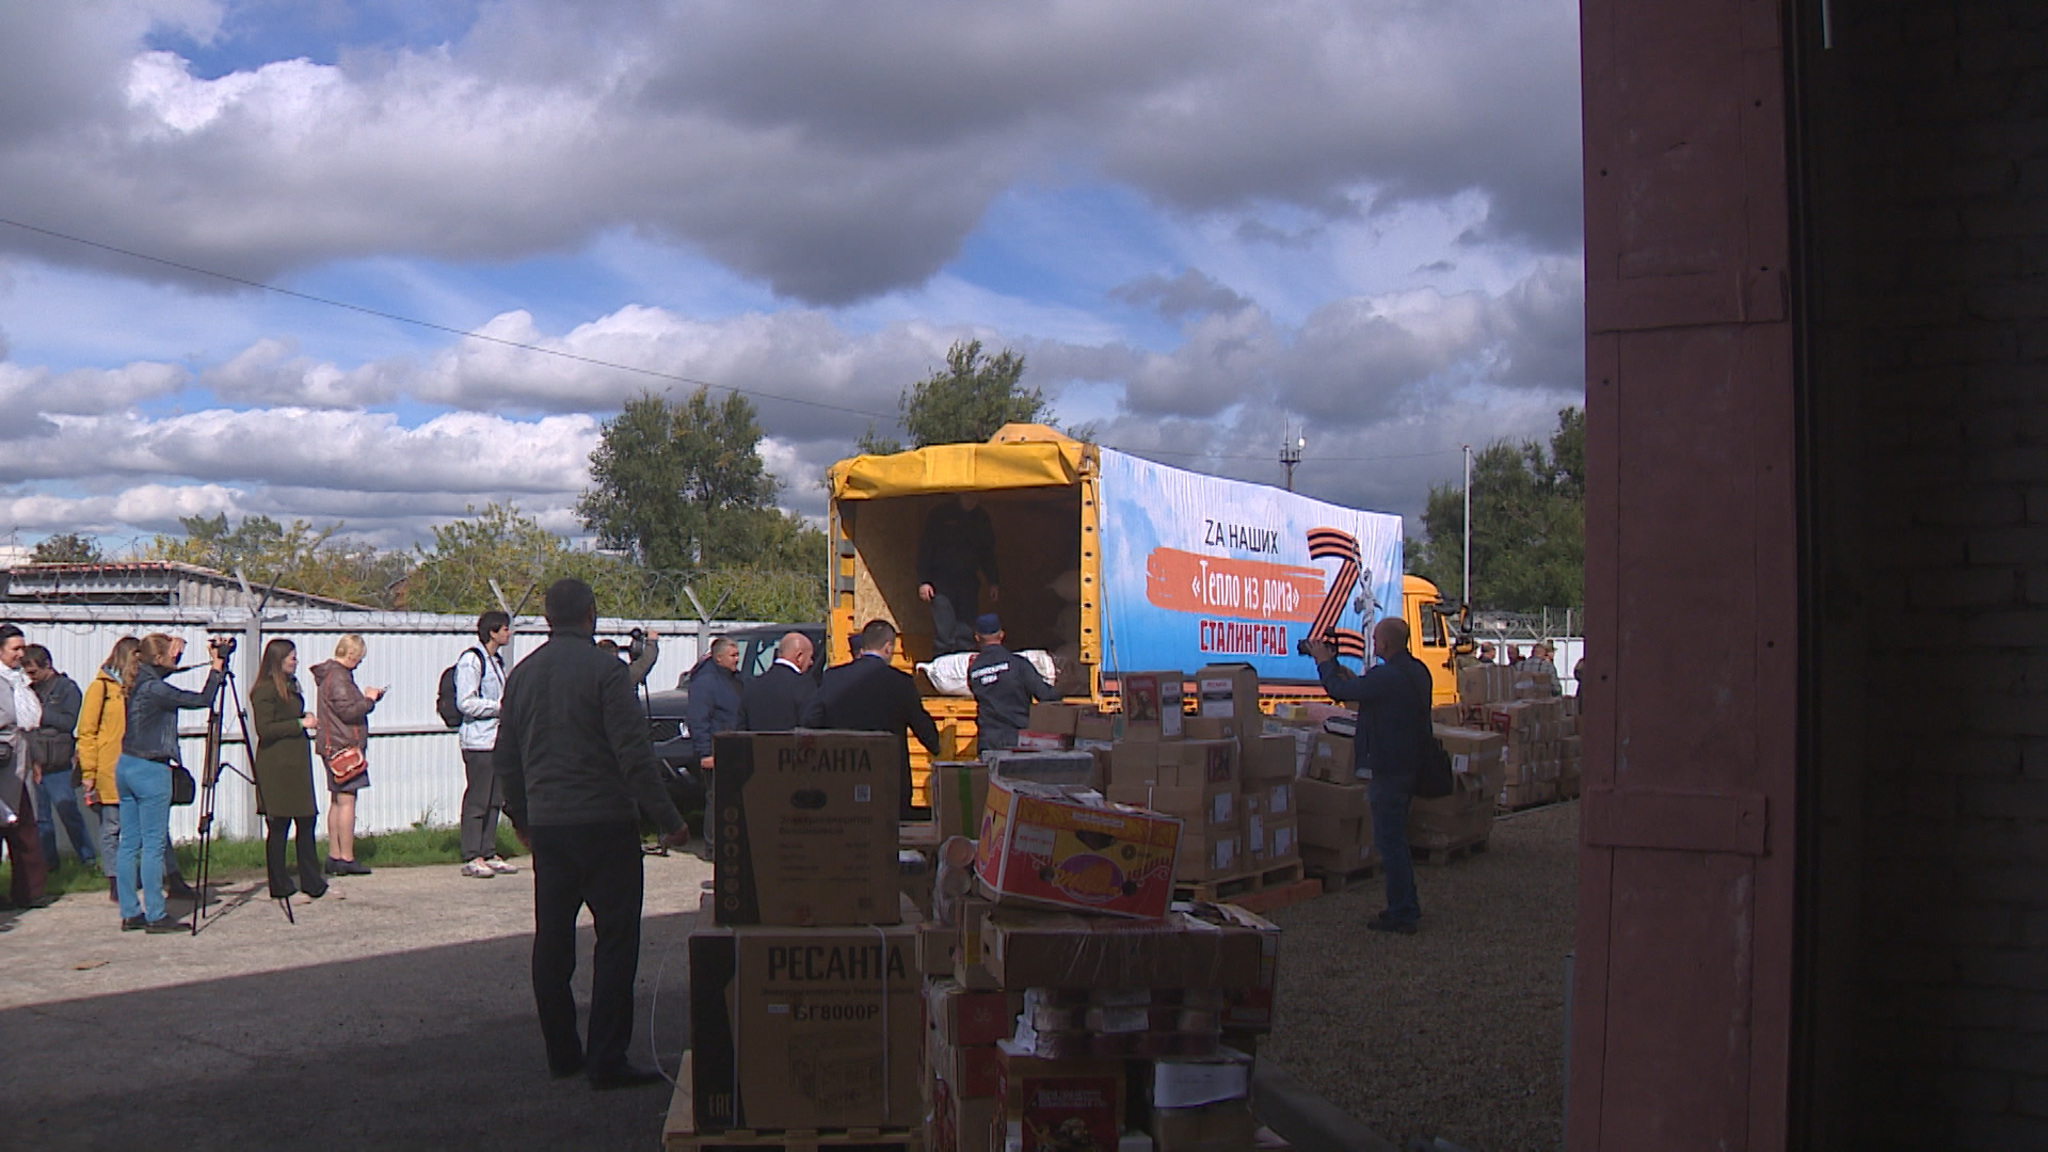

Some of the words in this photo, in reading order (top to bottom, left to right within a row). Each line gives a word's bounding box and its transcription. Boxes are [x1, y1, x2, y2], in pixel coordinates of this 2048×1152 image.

[1230, 524, 1279, 554] НАШИХ
[1245, 579, 1259, 609] из
[1199, 619, 1287, 656] СТАЛИНГРАД
[768, 946, 906, 981] РЕСАНТА
